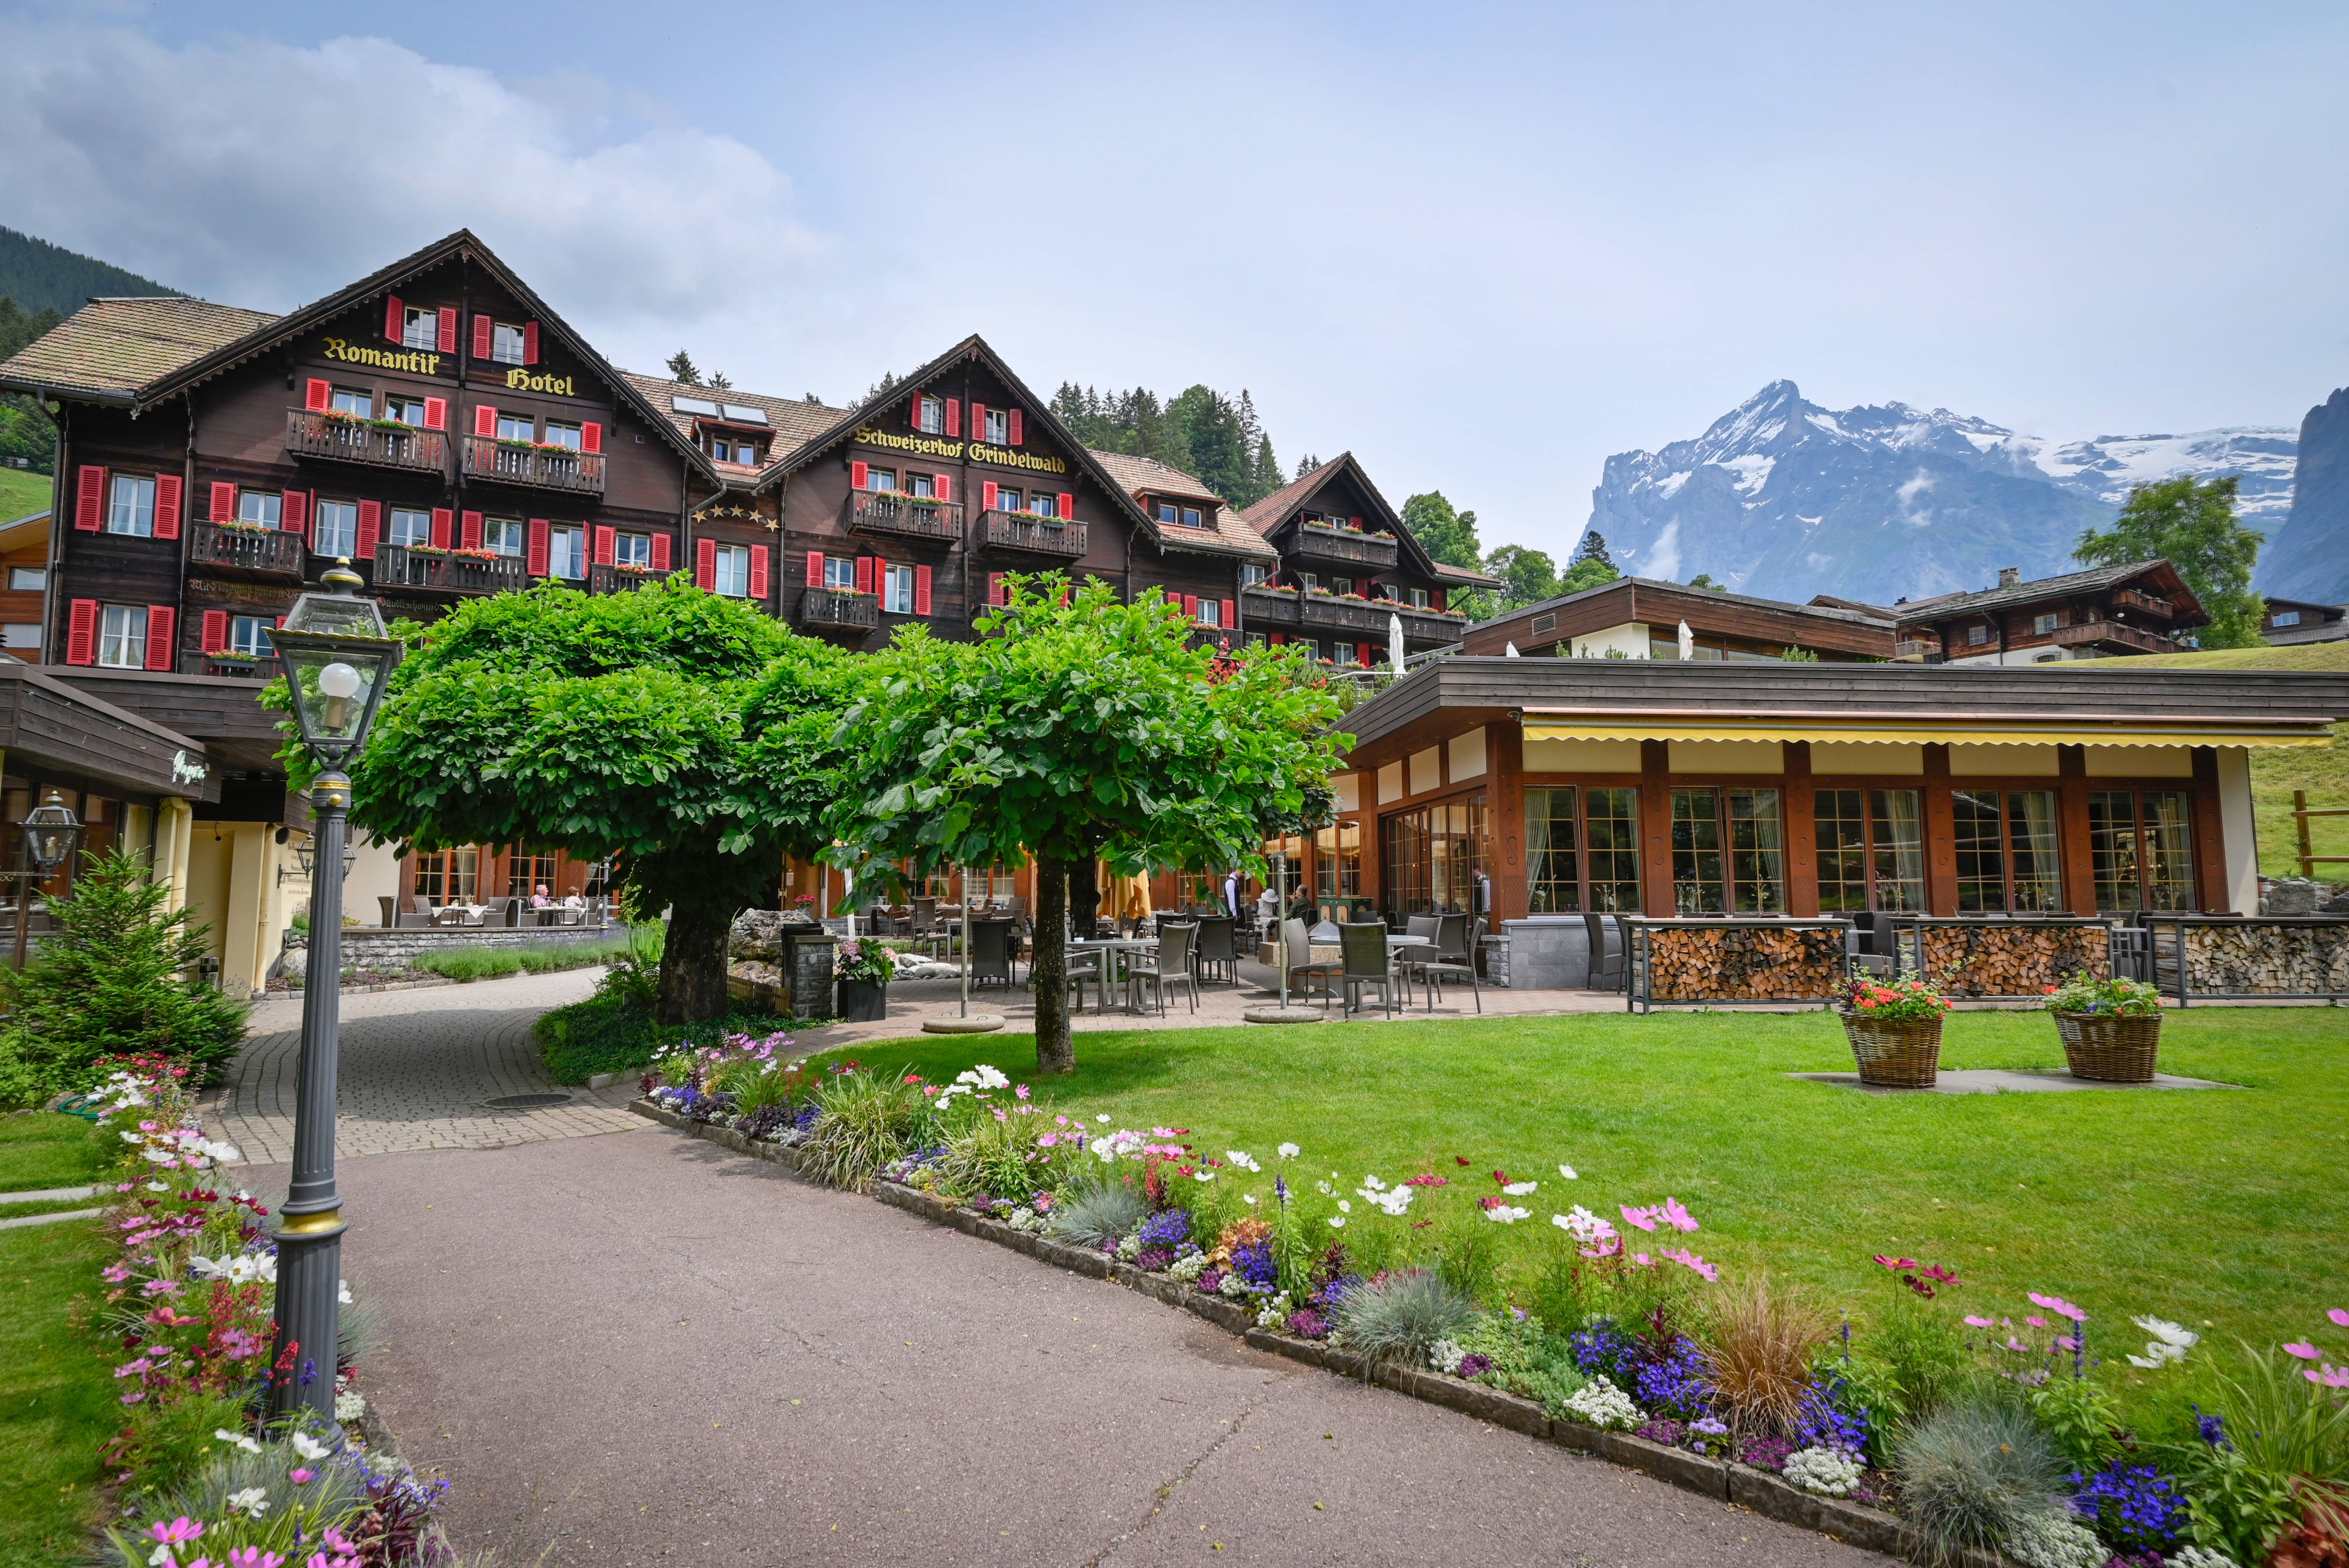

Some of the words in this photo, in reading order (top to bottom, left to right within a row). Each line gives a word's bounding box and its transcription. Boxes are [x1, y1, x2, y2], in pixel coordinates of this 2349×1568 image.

[322, 337, 440, 375] Romantik
[505, 367, 576, 397] Hotel
[854, 426, 964, 458] Schweizerhof
[968, 442, 1065, 474] Grindelwald
[188, 579, 209, 591] Mit
